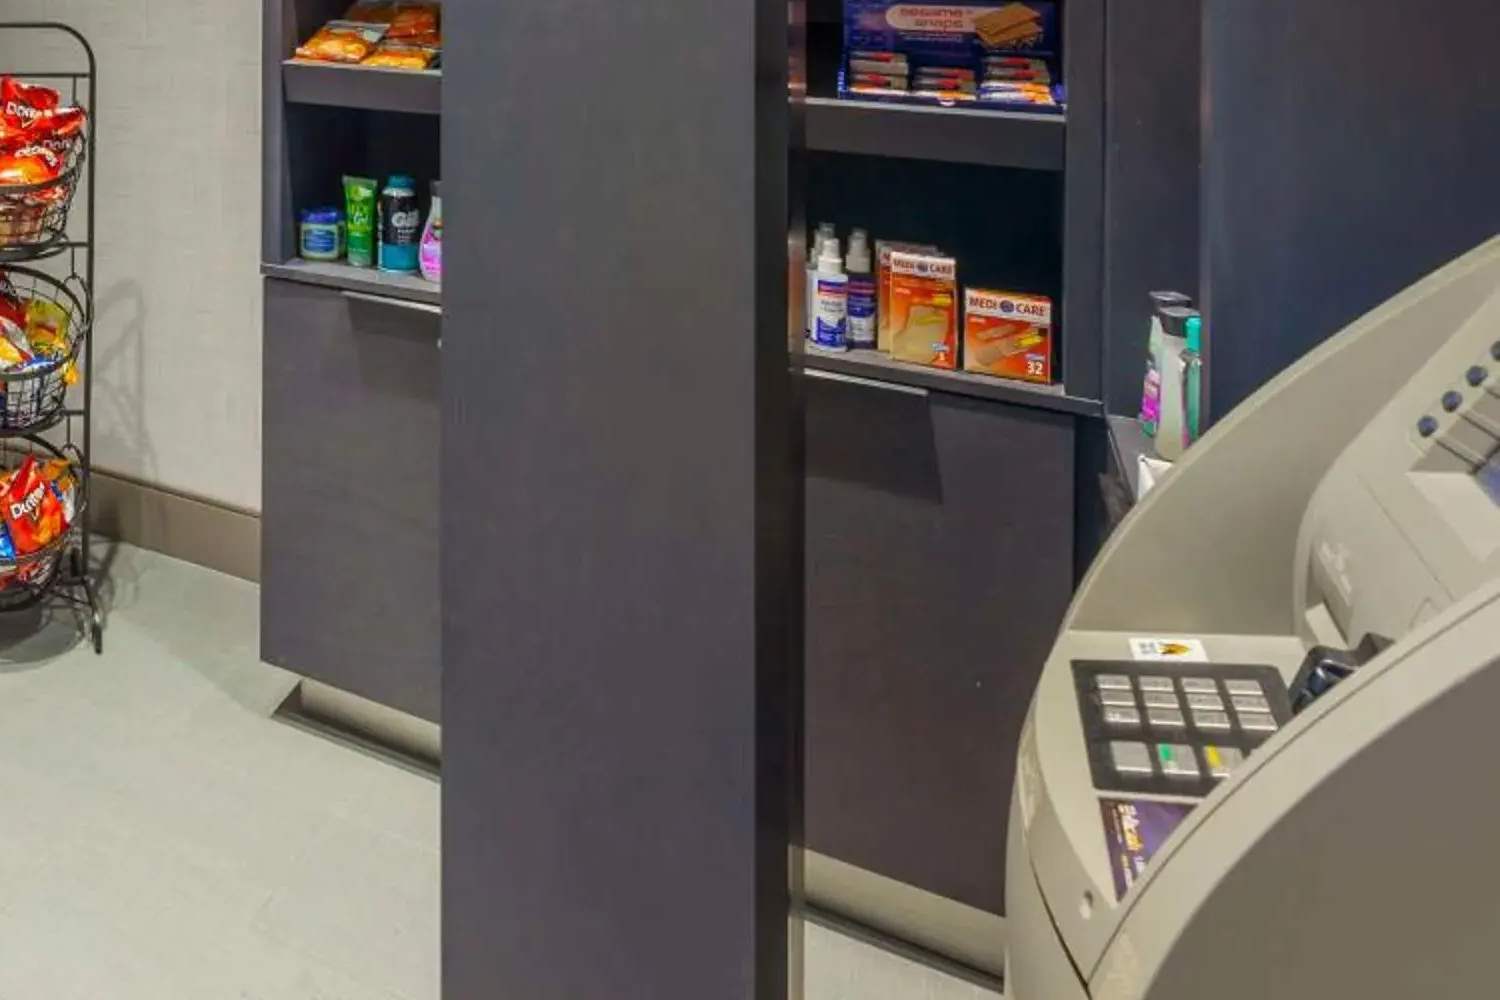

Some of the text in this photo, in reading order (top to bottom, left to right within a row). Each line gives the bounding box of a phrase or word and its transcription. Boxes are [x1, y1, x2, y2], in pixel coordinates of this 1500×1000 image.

[929, 263, 952, 275] CARE
[970, 295, 1046, 317] MEDI CARE
[1027, 360, 1044, 375] 32
